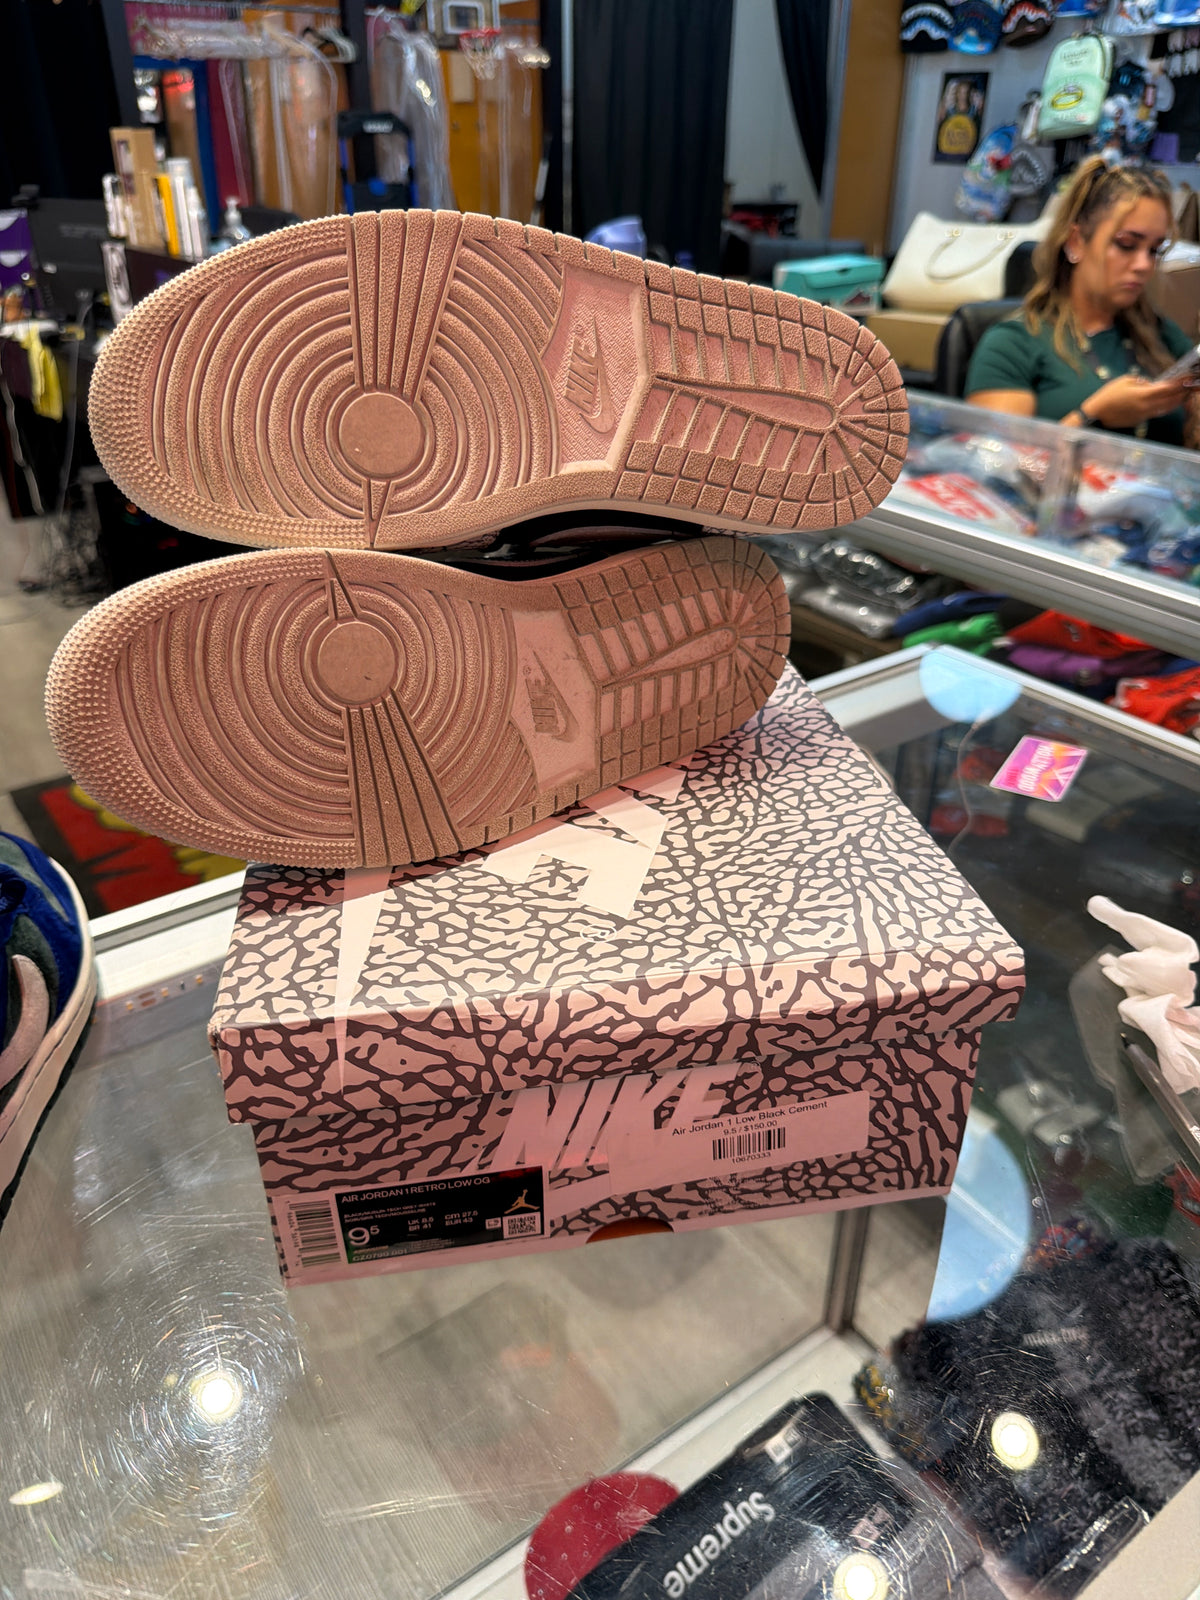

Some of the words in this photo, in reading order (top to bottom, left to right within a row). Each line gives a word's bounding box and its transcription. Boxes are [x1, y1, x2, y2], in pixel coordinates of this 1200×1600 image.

[563, 336, 599, 414] NIKE
[488, 1062, 742, 1172] NIKE
[672, 1127, 686, 1136] Air
[689, 1120, 724, 1133] Jordan
[735, 1114, 756, 1125] Low
[759, 1109, 786, 1120] Black
[788, 1101, 828, 1115] Cement
[723, 1127, 737, 1136] 9.5
[743, 1120, 778, 1132] $150.00
[341, 1194, 359, 1203] AIR
[360, 1188, 404, 1201] JORDAN
[410, 1182, 447, 1194] RETRO
[448, 1178, 472, 1189] LOW
[473, 1175, 491, 1185] OG
[663, 1491, 775, 1598] Supreme
